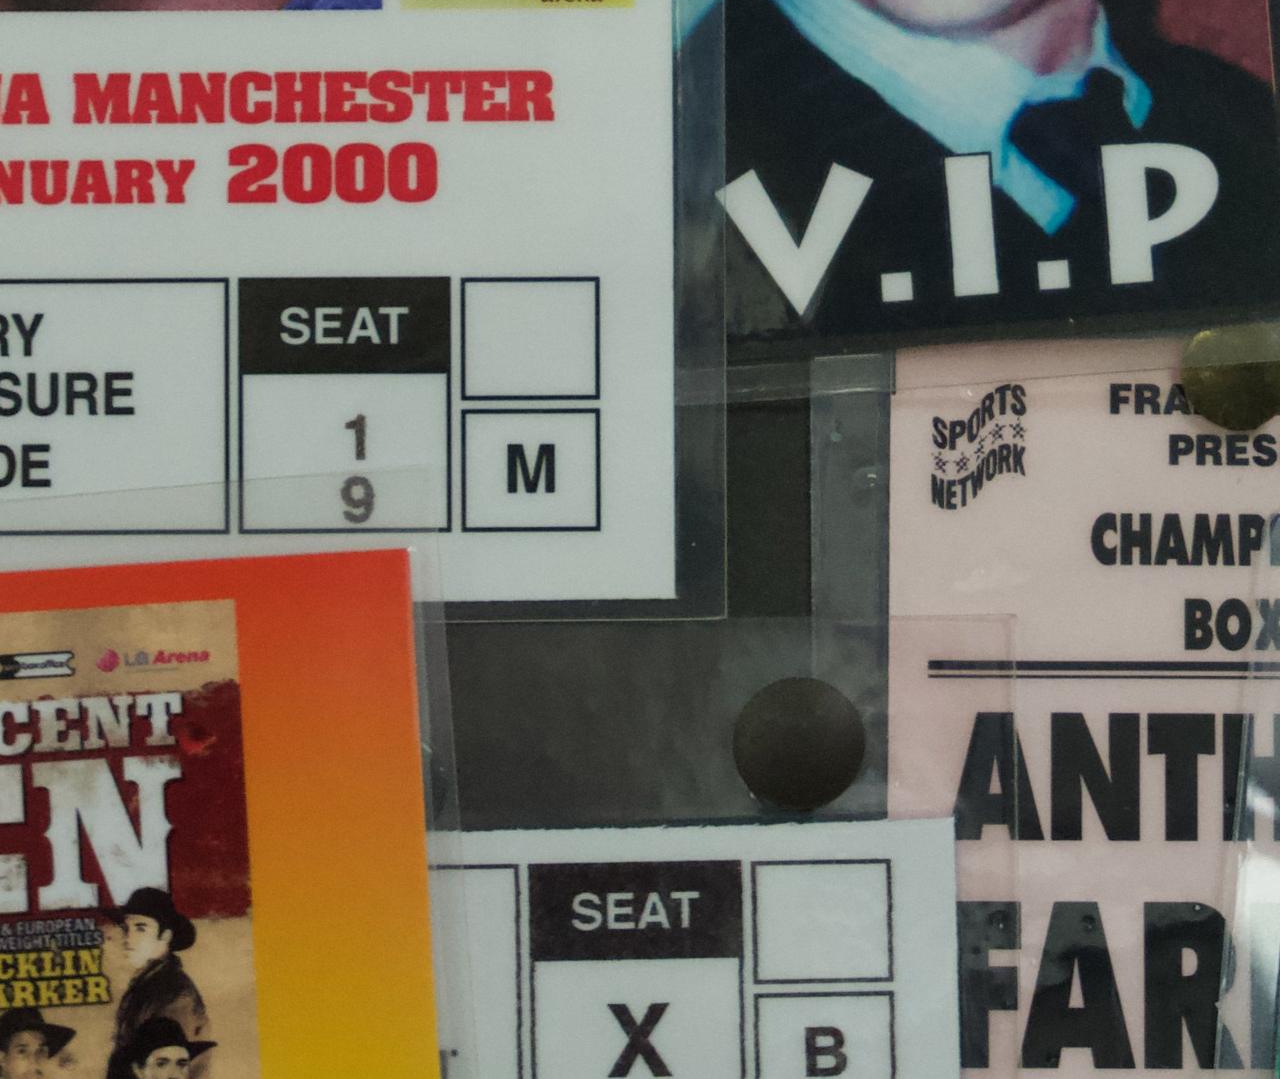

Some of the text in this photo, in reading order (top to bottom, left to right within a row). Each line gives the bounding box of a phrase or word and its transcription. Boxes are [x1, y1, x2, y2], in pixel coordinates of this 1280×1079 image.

[72, 70, 554, 123] MANCHESTER
[226, 142, 438, 203] 2000
[715, 142, 1219, 317] V.I.P
[279, 308, 410, 347] SEAT
[932, 384, 1026, 449] SPORTS
[1110, 383, 1197, 415] FRA
[345, 415, 366, 460] 1
[506, 445, 556, 495] M
[932, 443, 1026, 510] NETWORK
[340, 478, 376, 524] 9
[18, 918, 96, 936] EUROPEAN
[571, 891, 700, 931] SEAT
[54, 932, 103, 948] TITLES
[607, 1002, 672, 1078] X
[805, 1025, 847, 1078] B
